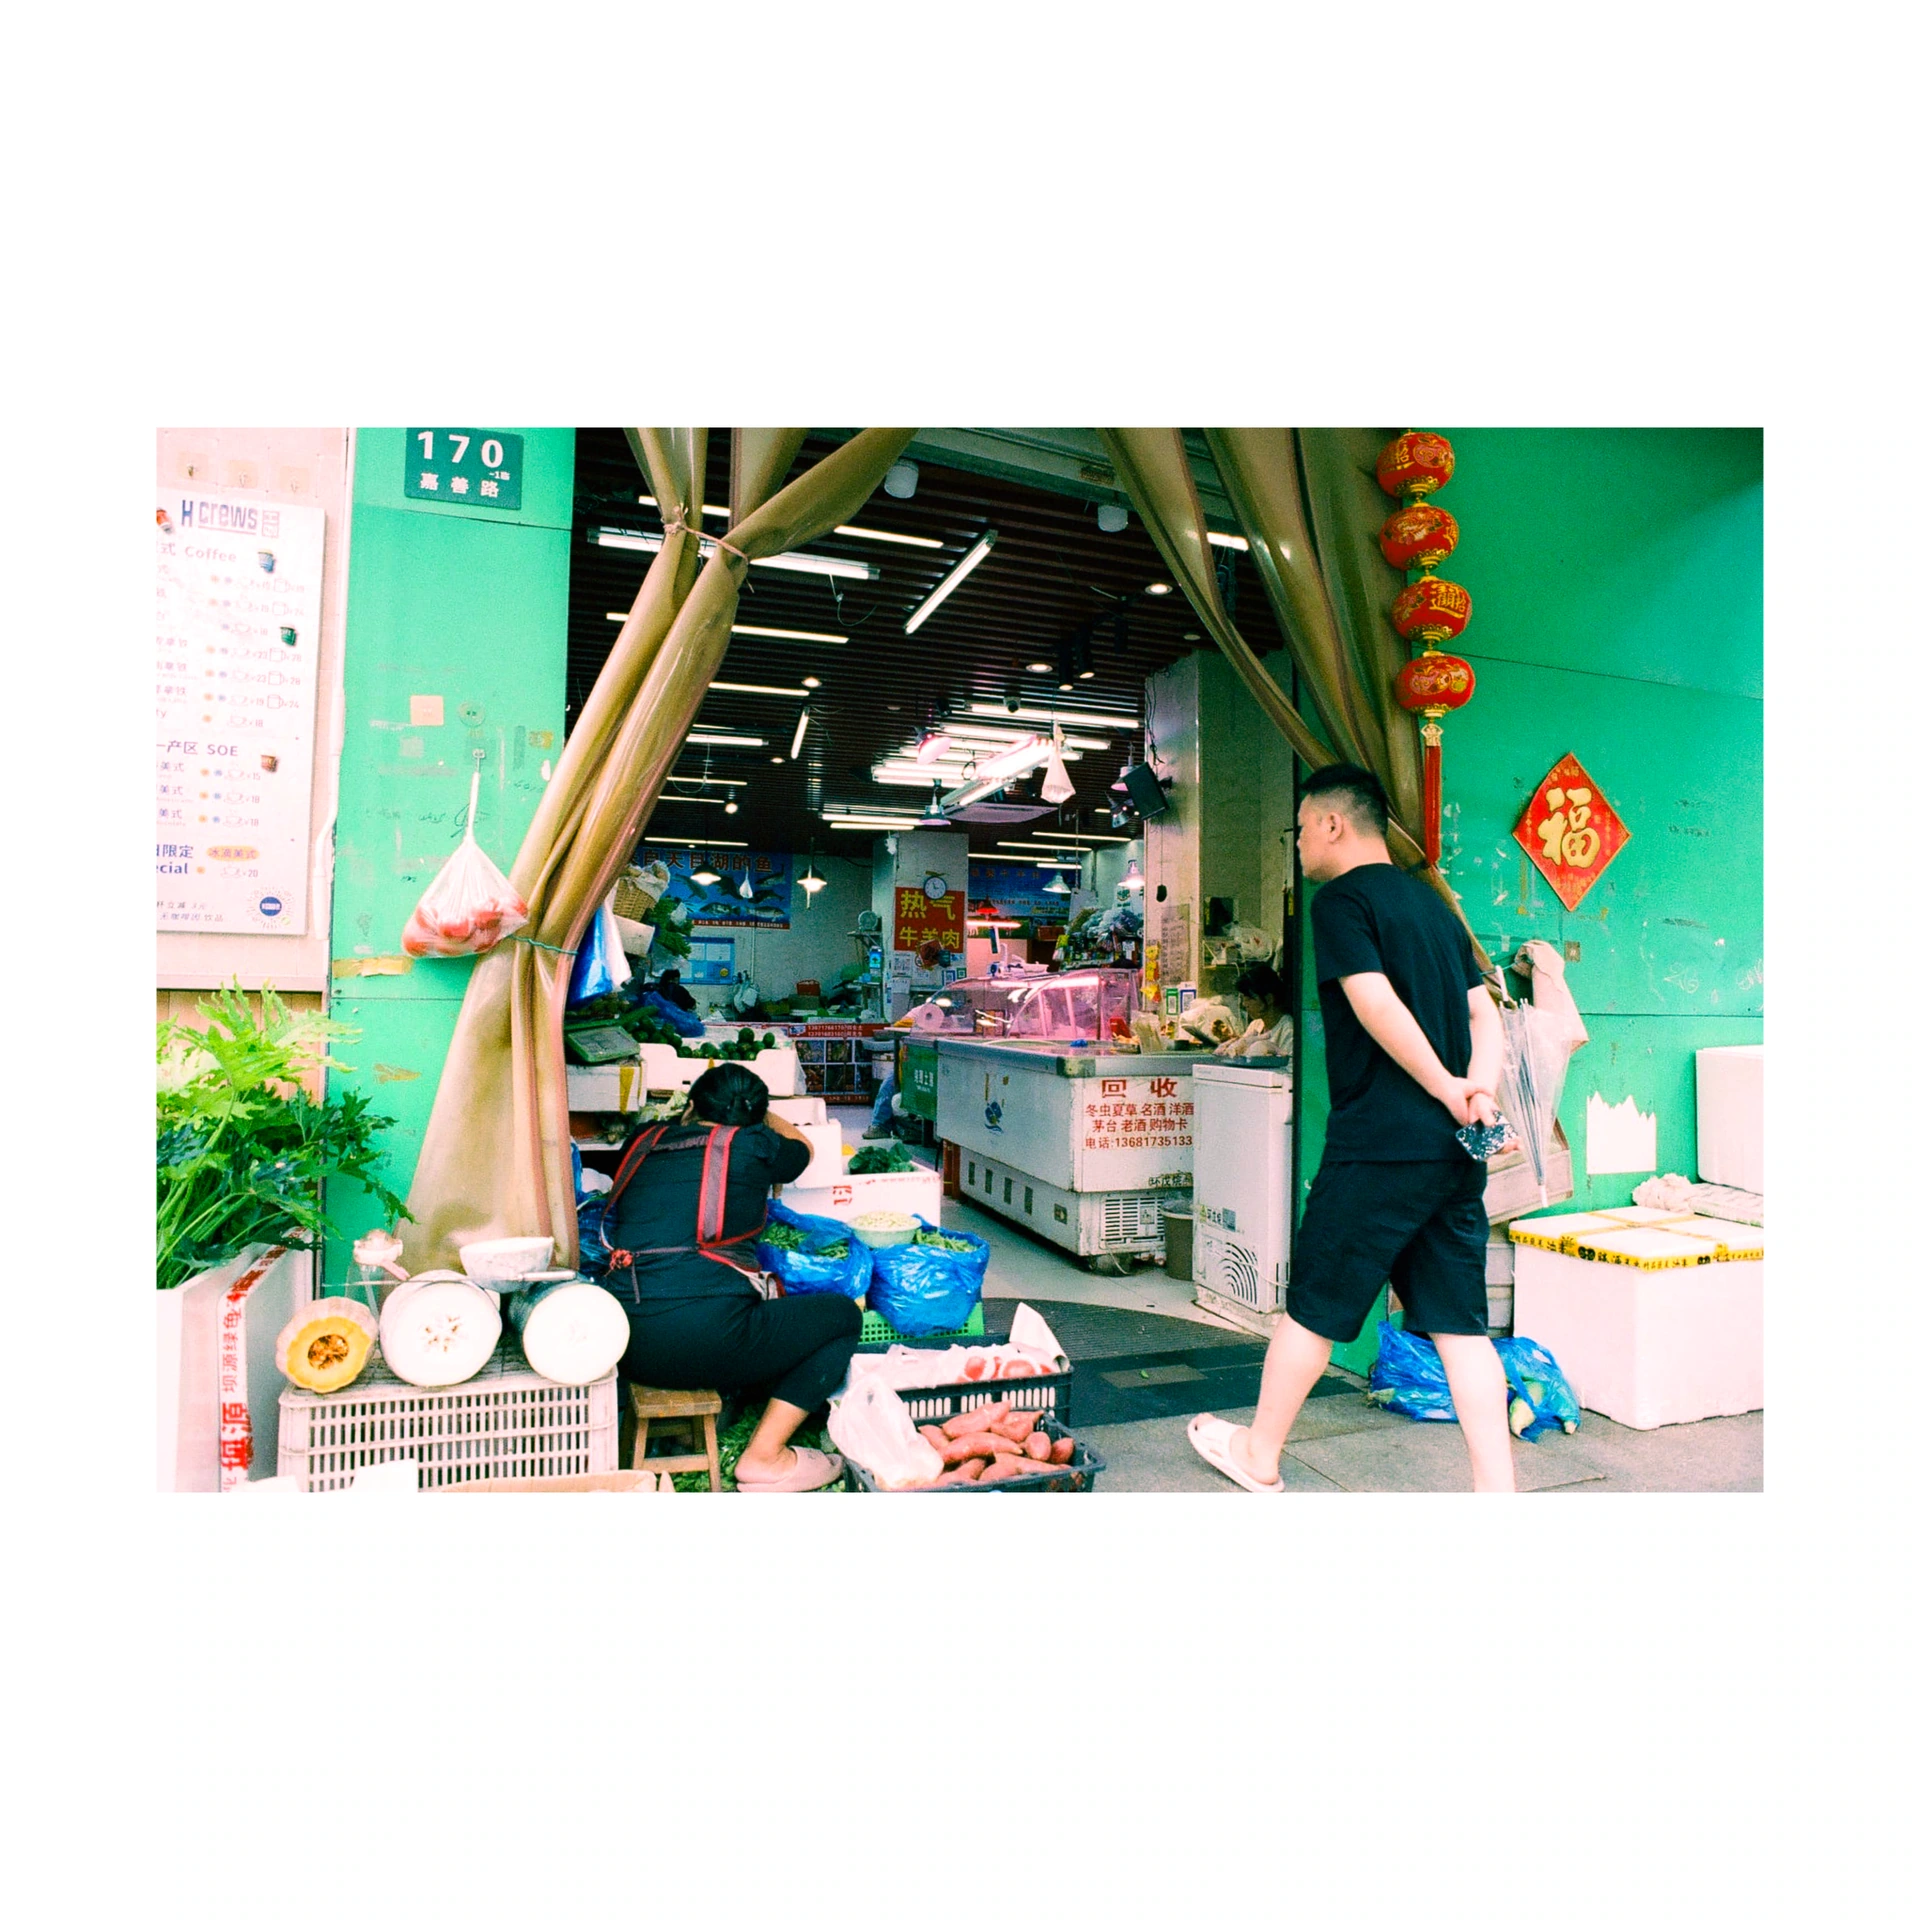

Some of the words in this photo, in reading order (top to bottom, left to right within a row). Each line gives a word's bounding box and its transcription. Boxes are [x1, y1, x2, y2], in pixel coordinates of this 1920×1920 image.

[418, 430, 504, 468] 170
[420, 472, 499, 498] 嘉善路
[181, 499, 194, 528] H
[198, 501, 258, 531] crews
[184, 545, 237, 562] Coffee
[206, 743, 239, 757] SOE
[1537, 787, 1601, 869] 福
[900, 890, 956, 921] 热气
[899, 927, 961, 950] 牛羊肉
[1101, 1078, 1178, 1099] 回收
[1085, 1103, 1138, 1117] 冬虫夏草
[1140, 1103, 1166, 1116] 名酒
[1169, 1102, 1194, 1115] 洋酒
[1092, 1119, 1117, 1133] 茅台
[1121, 1119, 1147, 1132] 老酒
[1149, 1118, 1188, 1131] 购物卡
